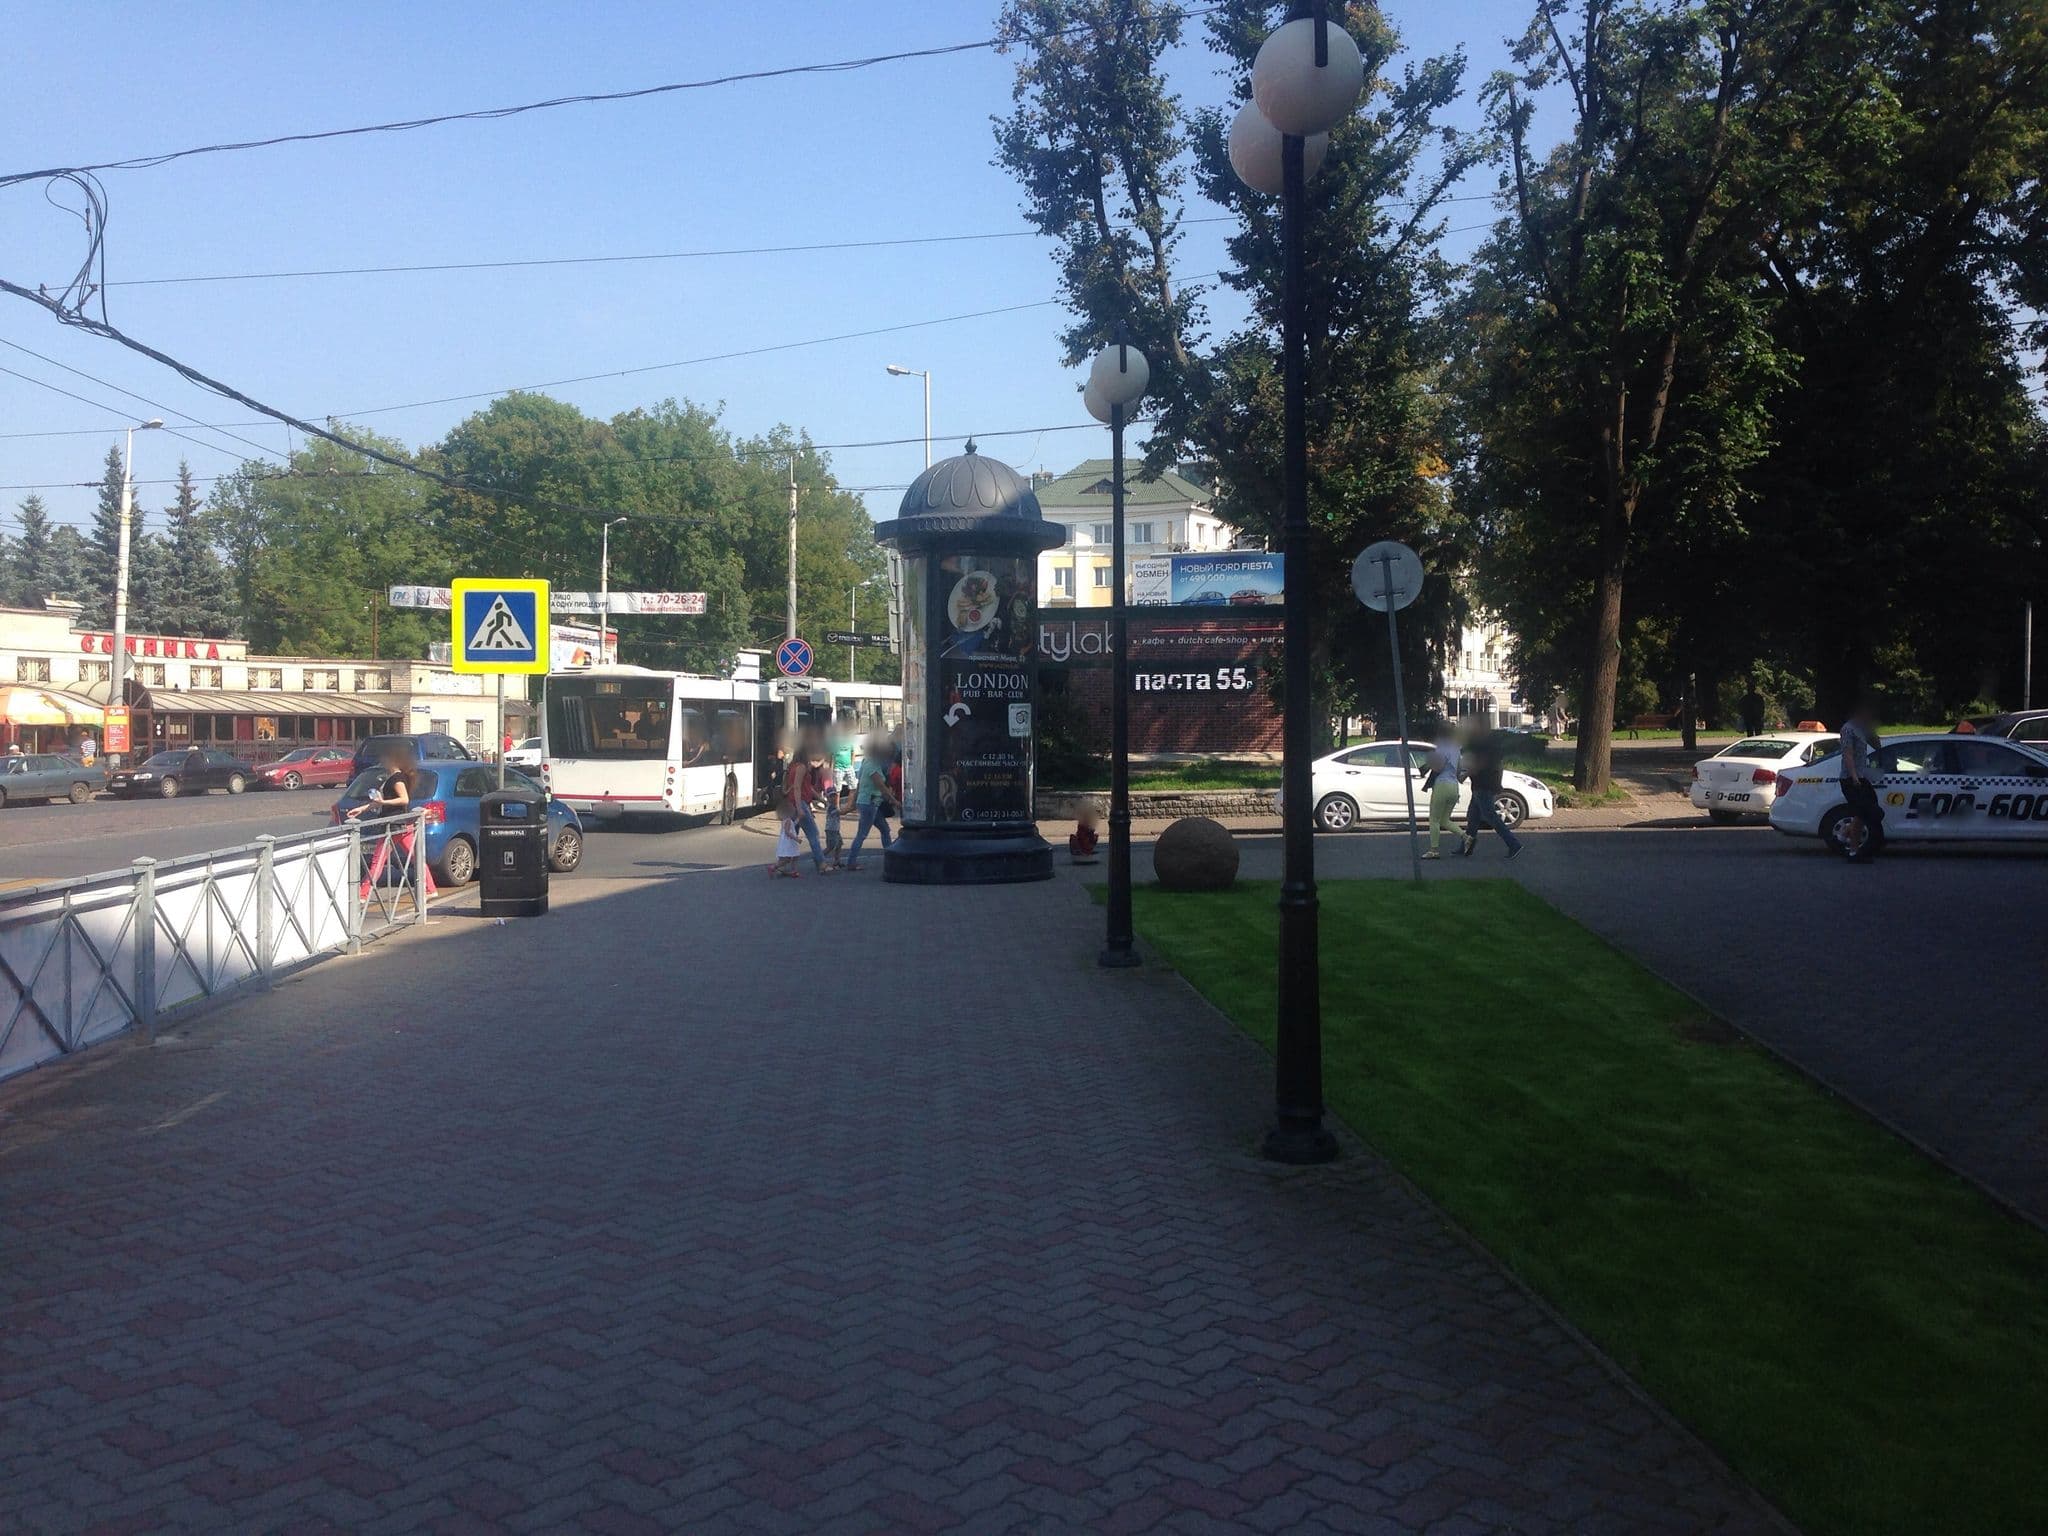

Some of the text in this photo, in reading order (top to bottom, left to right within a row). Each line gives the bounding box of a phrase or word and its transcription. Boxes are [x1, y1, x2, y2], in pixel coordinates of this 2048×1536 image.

[1181, 560, 1274, 574] НОВЫЙ FORD FIESTA
[1136, 569, 1169, 578] ОБМЕН
[1177, 636, 1205, 644] dutch
[82, 634, 219, 660] СОЛЯНКА
[957, 673, 1028, 689] LONDON
[1135, 673, 1211, 690] паста
[987, 690, 1004, 698] BAR
[1705, 791, 1751, 802] 50-600
